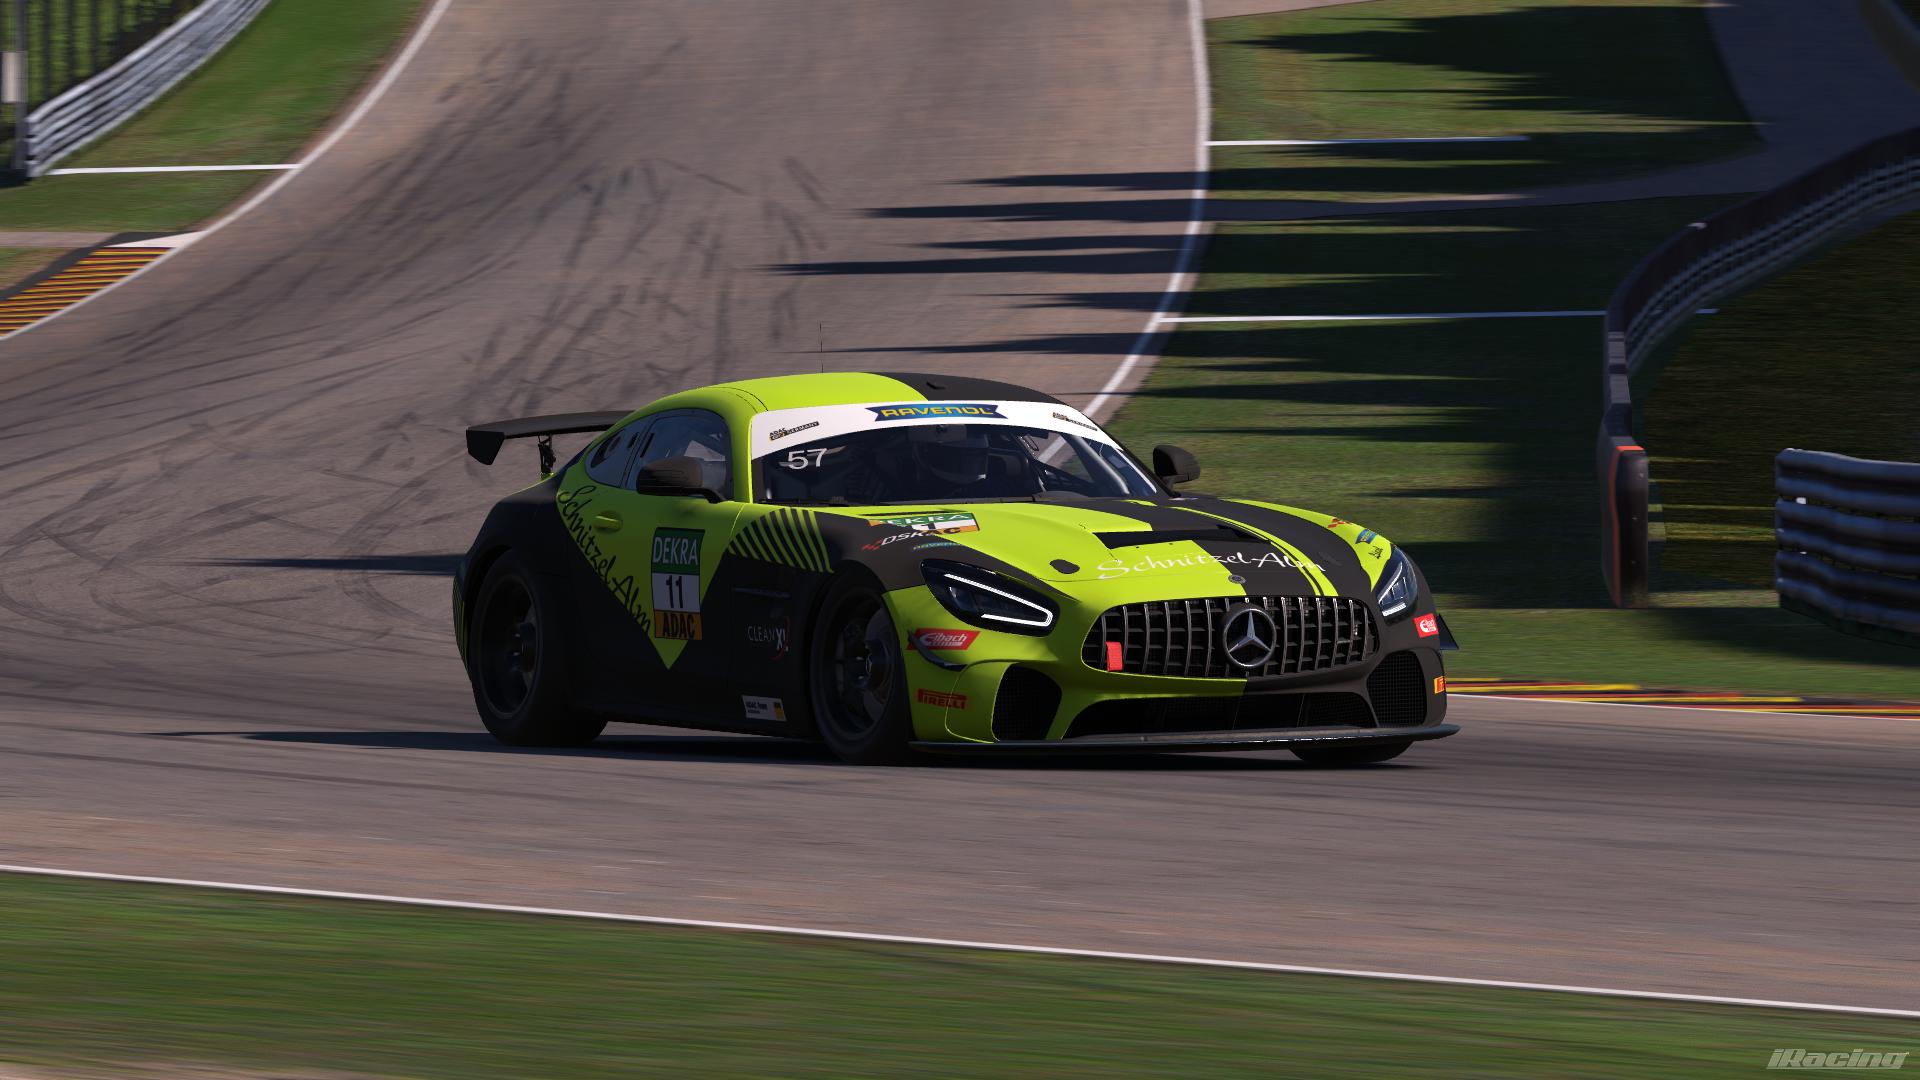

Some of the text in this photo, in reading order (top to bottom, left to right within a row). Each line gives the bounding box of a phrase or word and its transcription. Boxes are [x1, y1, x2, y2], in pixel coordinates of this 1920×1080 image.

[880, 406, 994, 417] RAVENOL
[787, 448, 828, 470] 57
[880, 513, 970, 528] EKRA
[653, 536, 699, 565] DEKRA
[665, 575, 684, 609] 11
[662, 613, 696, 639] ADAC
[919, 632, 968, 647] Eibach
[917, 688, 967, 709] PIRELLI
